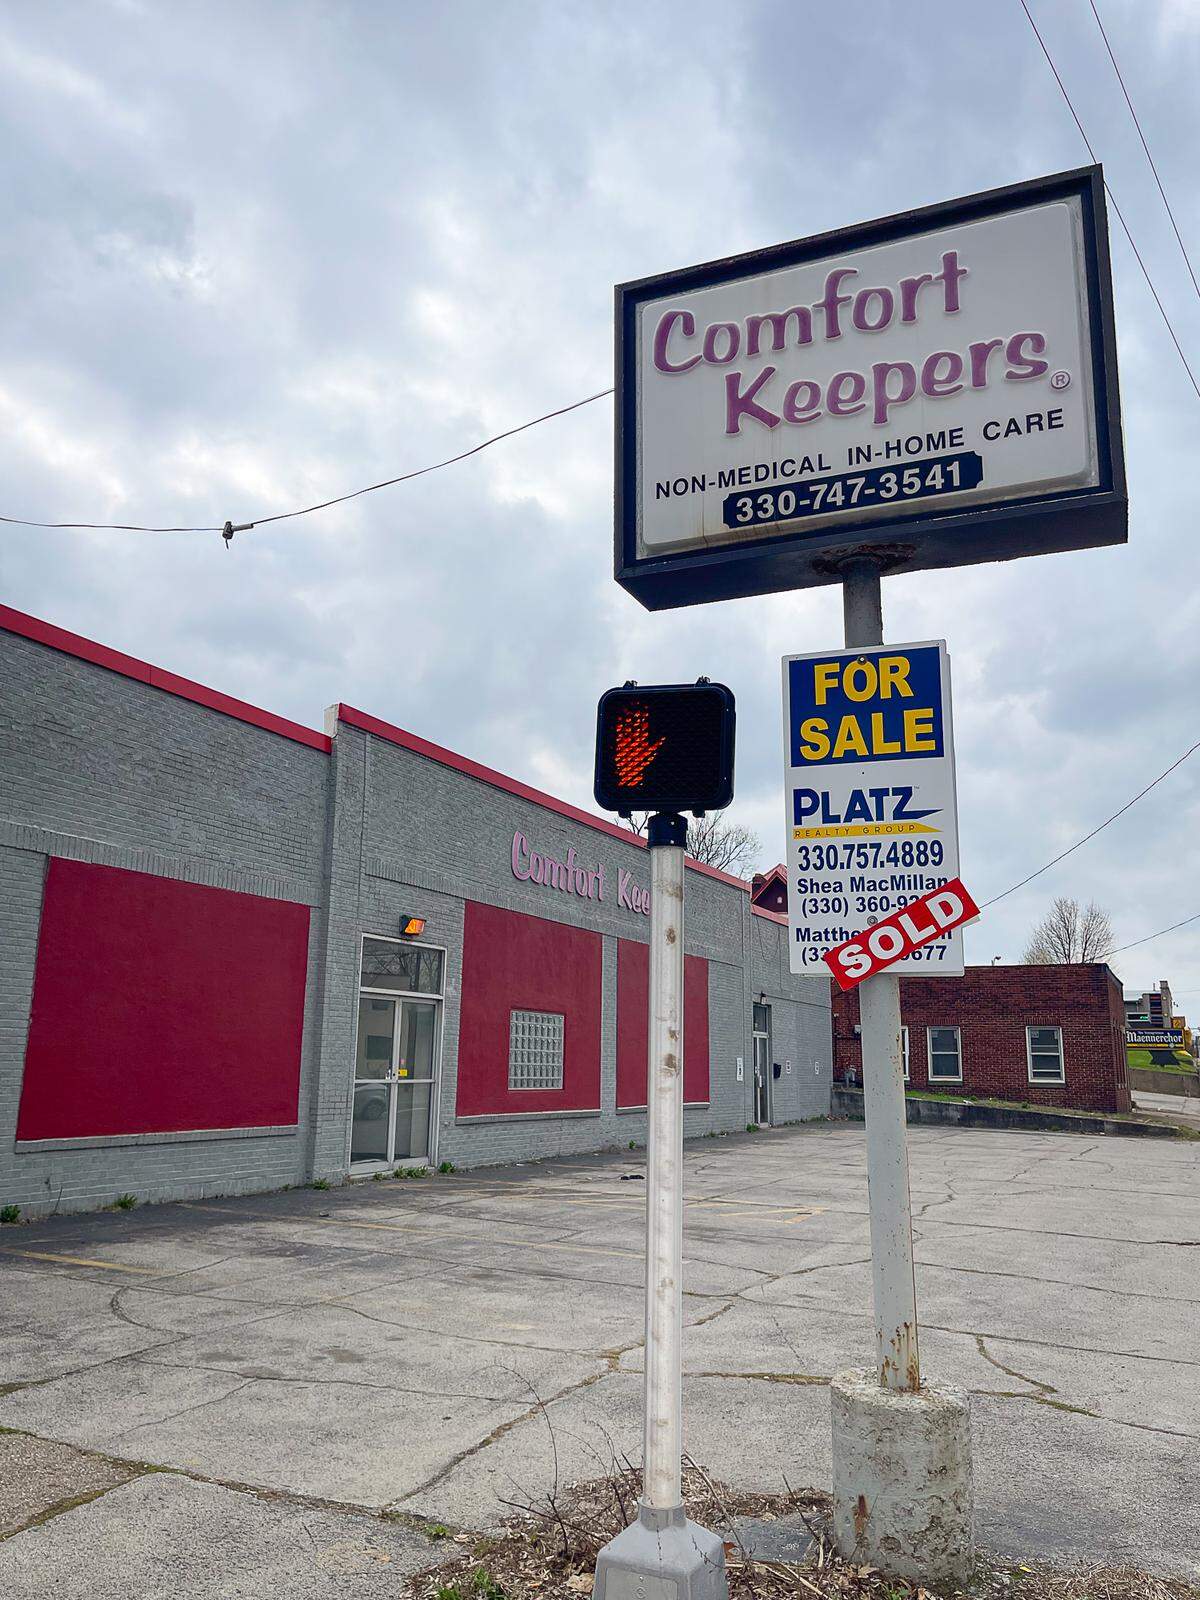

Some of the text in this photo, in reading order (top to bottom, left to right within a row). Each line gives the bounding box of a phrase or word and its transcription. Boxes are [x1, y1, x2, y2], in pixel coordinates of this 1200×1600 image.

[653, 250, 968, 374] Comfort
[655, 408, 1065, 499] NON-MEDICAL IN-HOME CARE
[735, 460, 963, 523] 330-747-3541
[814, 655, 914, 706] FOR
[799, 708, 936, 761] SALE
[793, 786, 944, 826] PLATZ
[795, 824, 916, 838] REALTY GROUP
[511, 830, 651, 916] Comfort Kee
[798, 839, 944, 871] 330.757.4889
[797, 877, 843, 894] Shea
[801, 896, 849, 918] (330)
[837, 890, 965, 979] SOLD
[1125, 1030, 1182, 1043] Maennerchor
